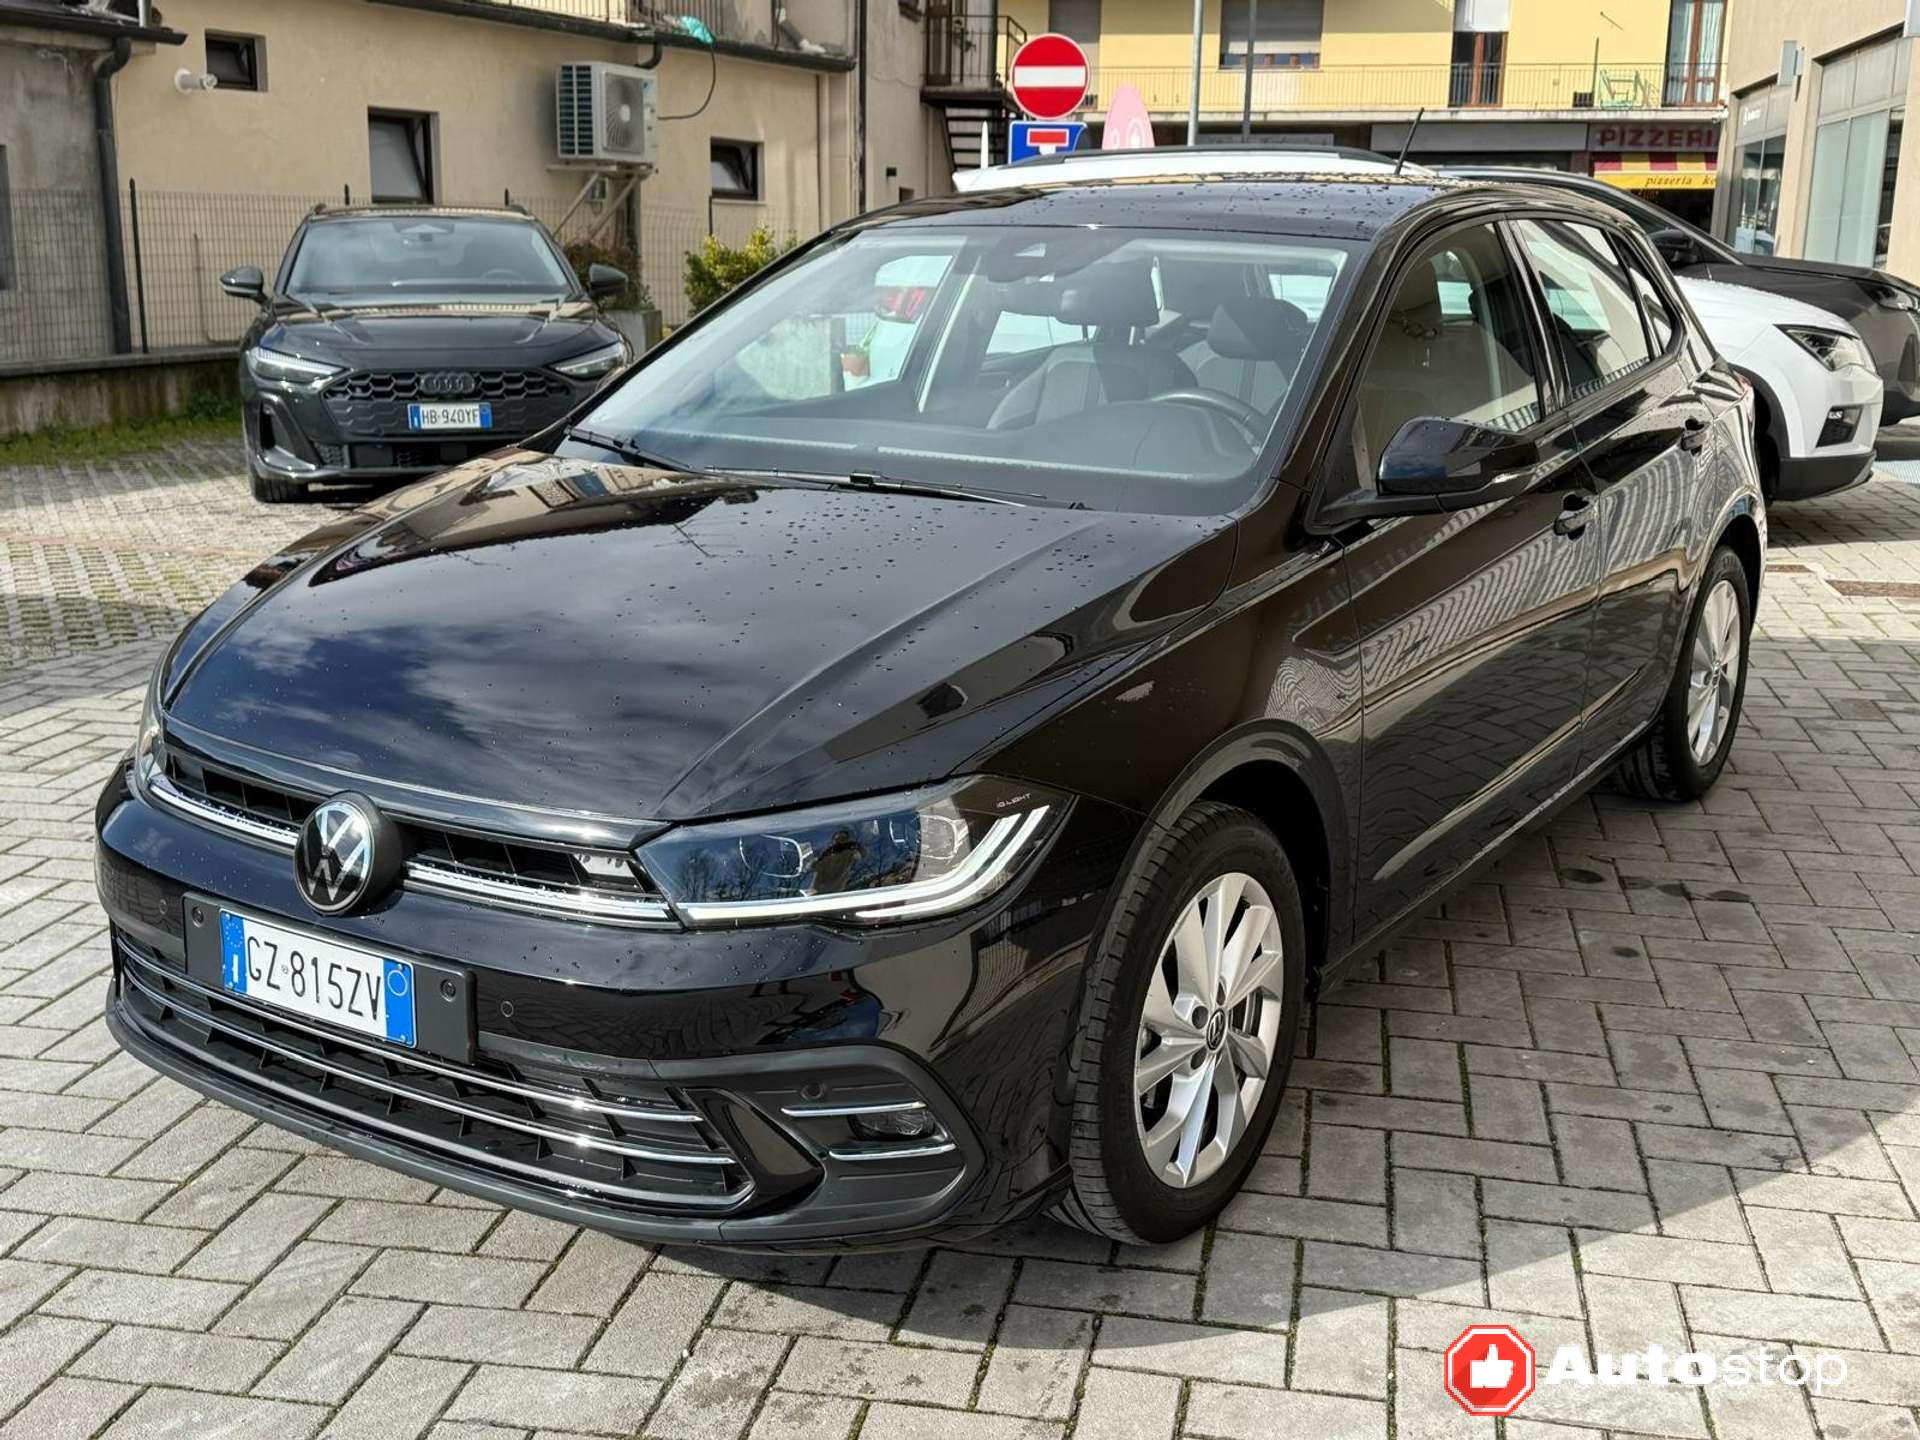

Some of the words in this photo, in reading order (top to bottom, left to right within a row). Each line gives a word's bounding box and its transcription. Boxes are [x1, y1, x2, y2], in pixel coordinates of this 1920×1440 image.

[1600, 128, 1719, 147] PIZZERI
[1645, 175, 1693, 187] pizzeria
[247, 936, 281, 991] GZ
[290, 950, 381, 1021] 815ZV
